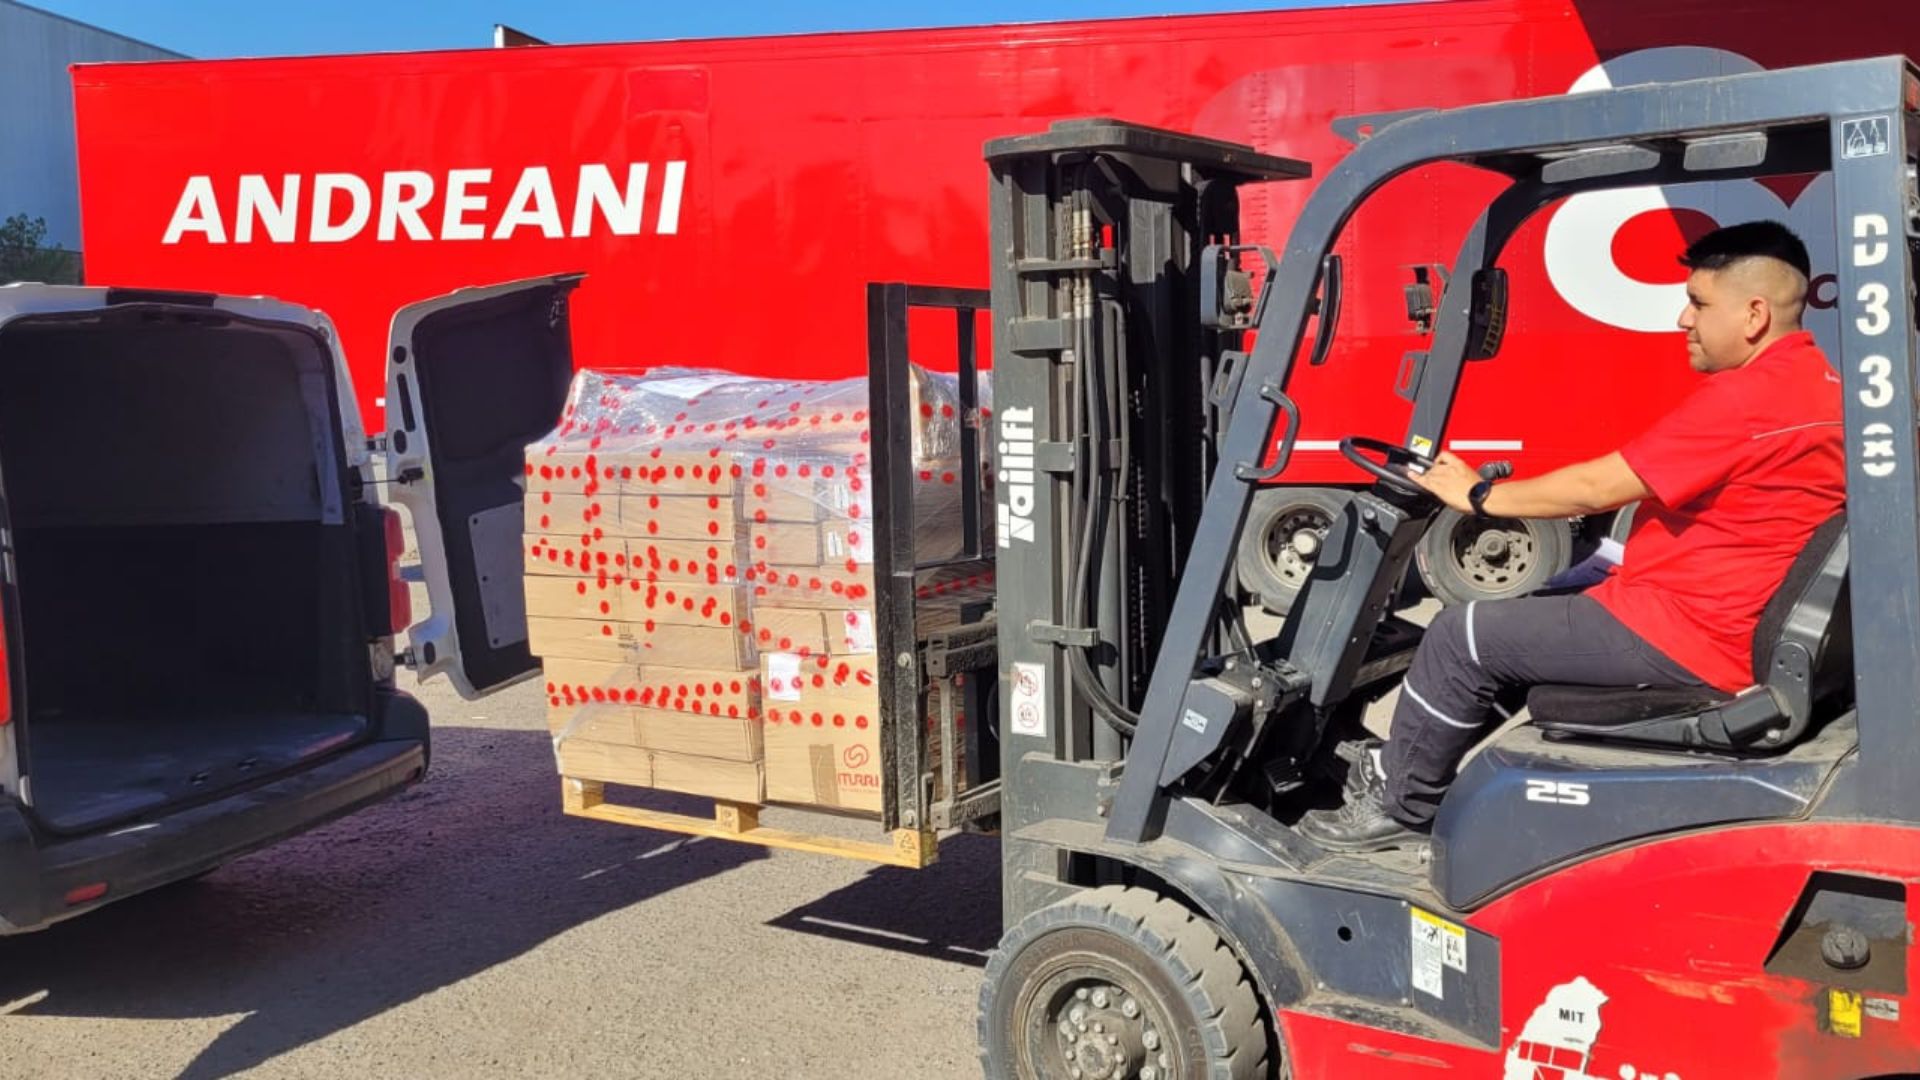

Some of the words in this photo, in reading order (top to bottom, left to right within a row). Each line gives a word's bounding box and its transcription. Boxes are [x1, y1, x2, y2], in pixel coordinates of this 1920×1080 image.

[161, 160, 687, 244] ANDREANI
[998, 406, 1035, 549] Tailift
[1526, 779, 1590, 806] 25
[1558, 1007, 1585, 1023] MIT
